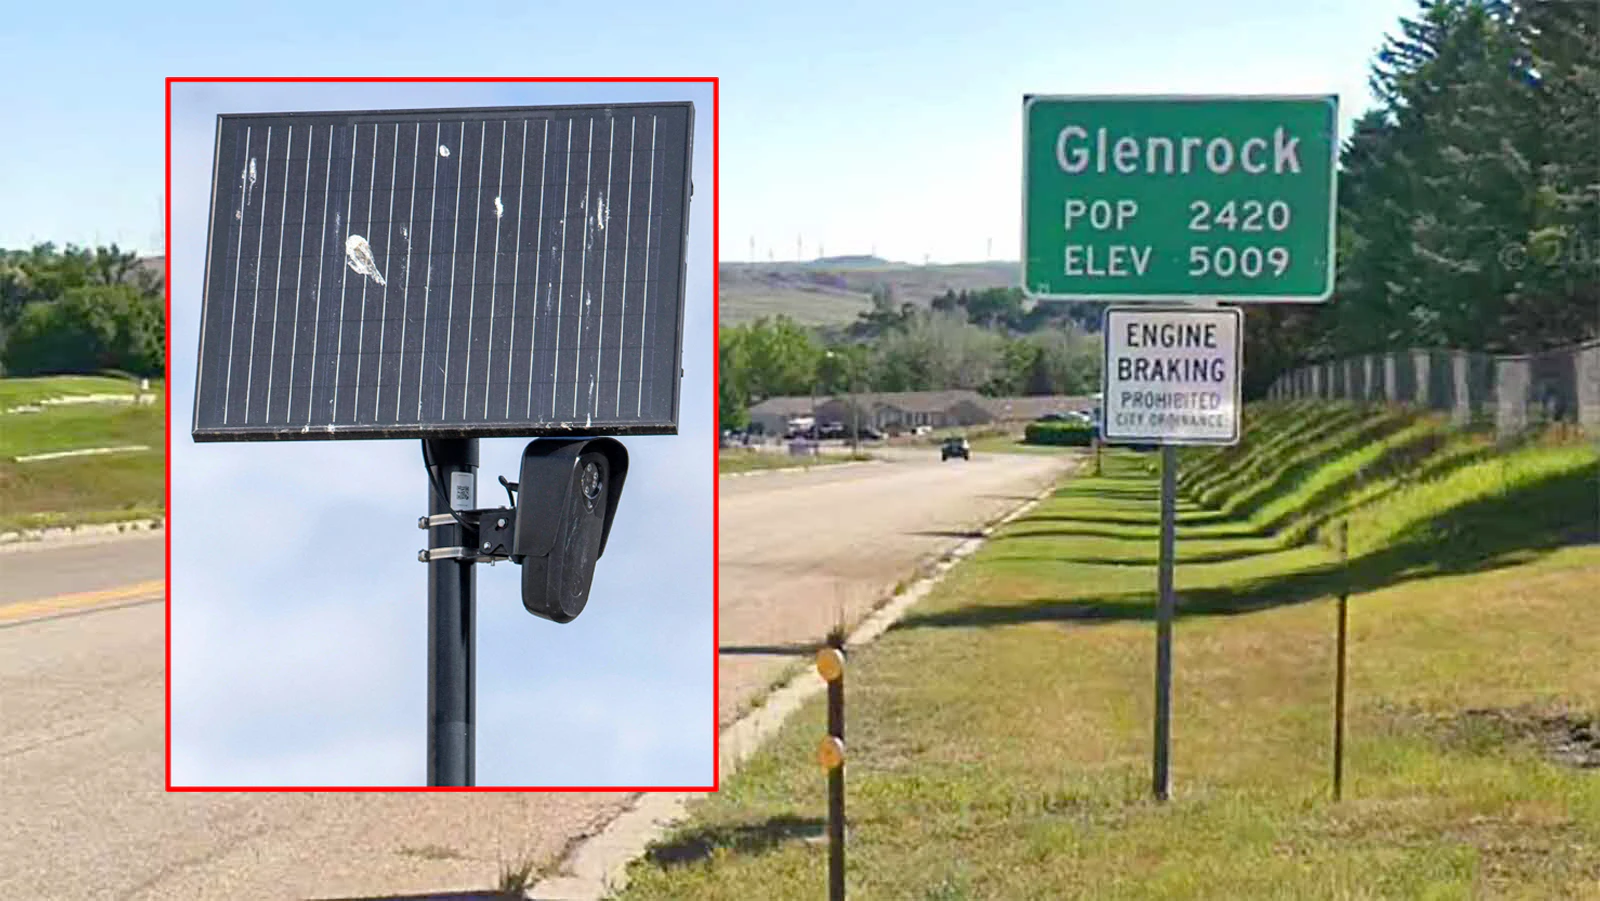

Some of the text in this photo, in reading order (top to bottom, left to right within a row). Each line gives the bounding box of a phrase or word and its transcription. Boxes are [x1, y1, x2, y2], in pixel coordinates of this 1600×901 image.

[1056, 125, 1301, 174] Glenrock
[1063, 200, 1291, 231] POP 2420
[1063, 246, 1290, 277] ELEV 5009
[1126, 323, 1217, 348] ENGINE
[1117, 358, 1226, 382] BRAKING
[1120, 391, 1222, 410] PROHIBITED
[1116, 412, 1224, 429] CITY ORDINANCE
